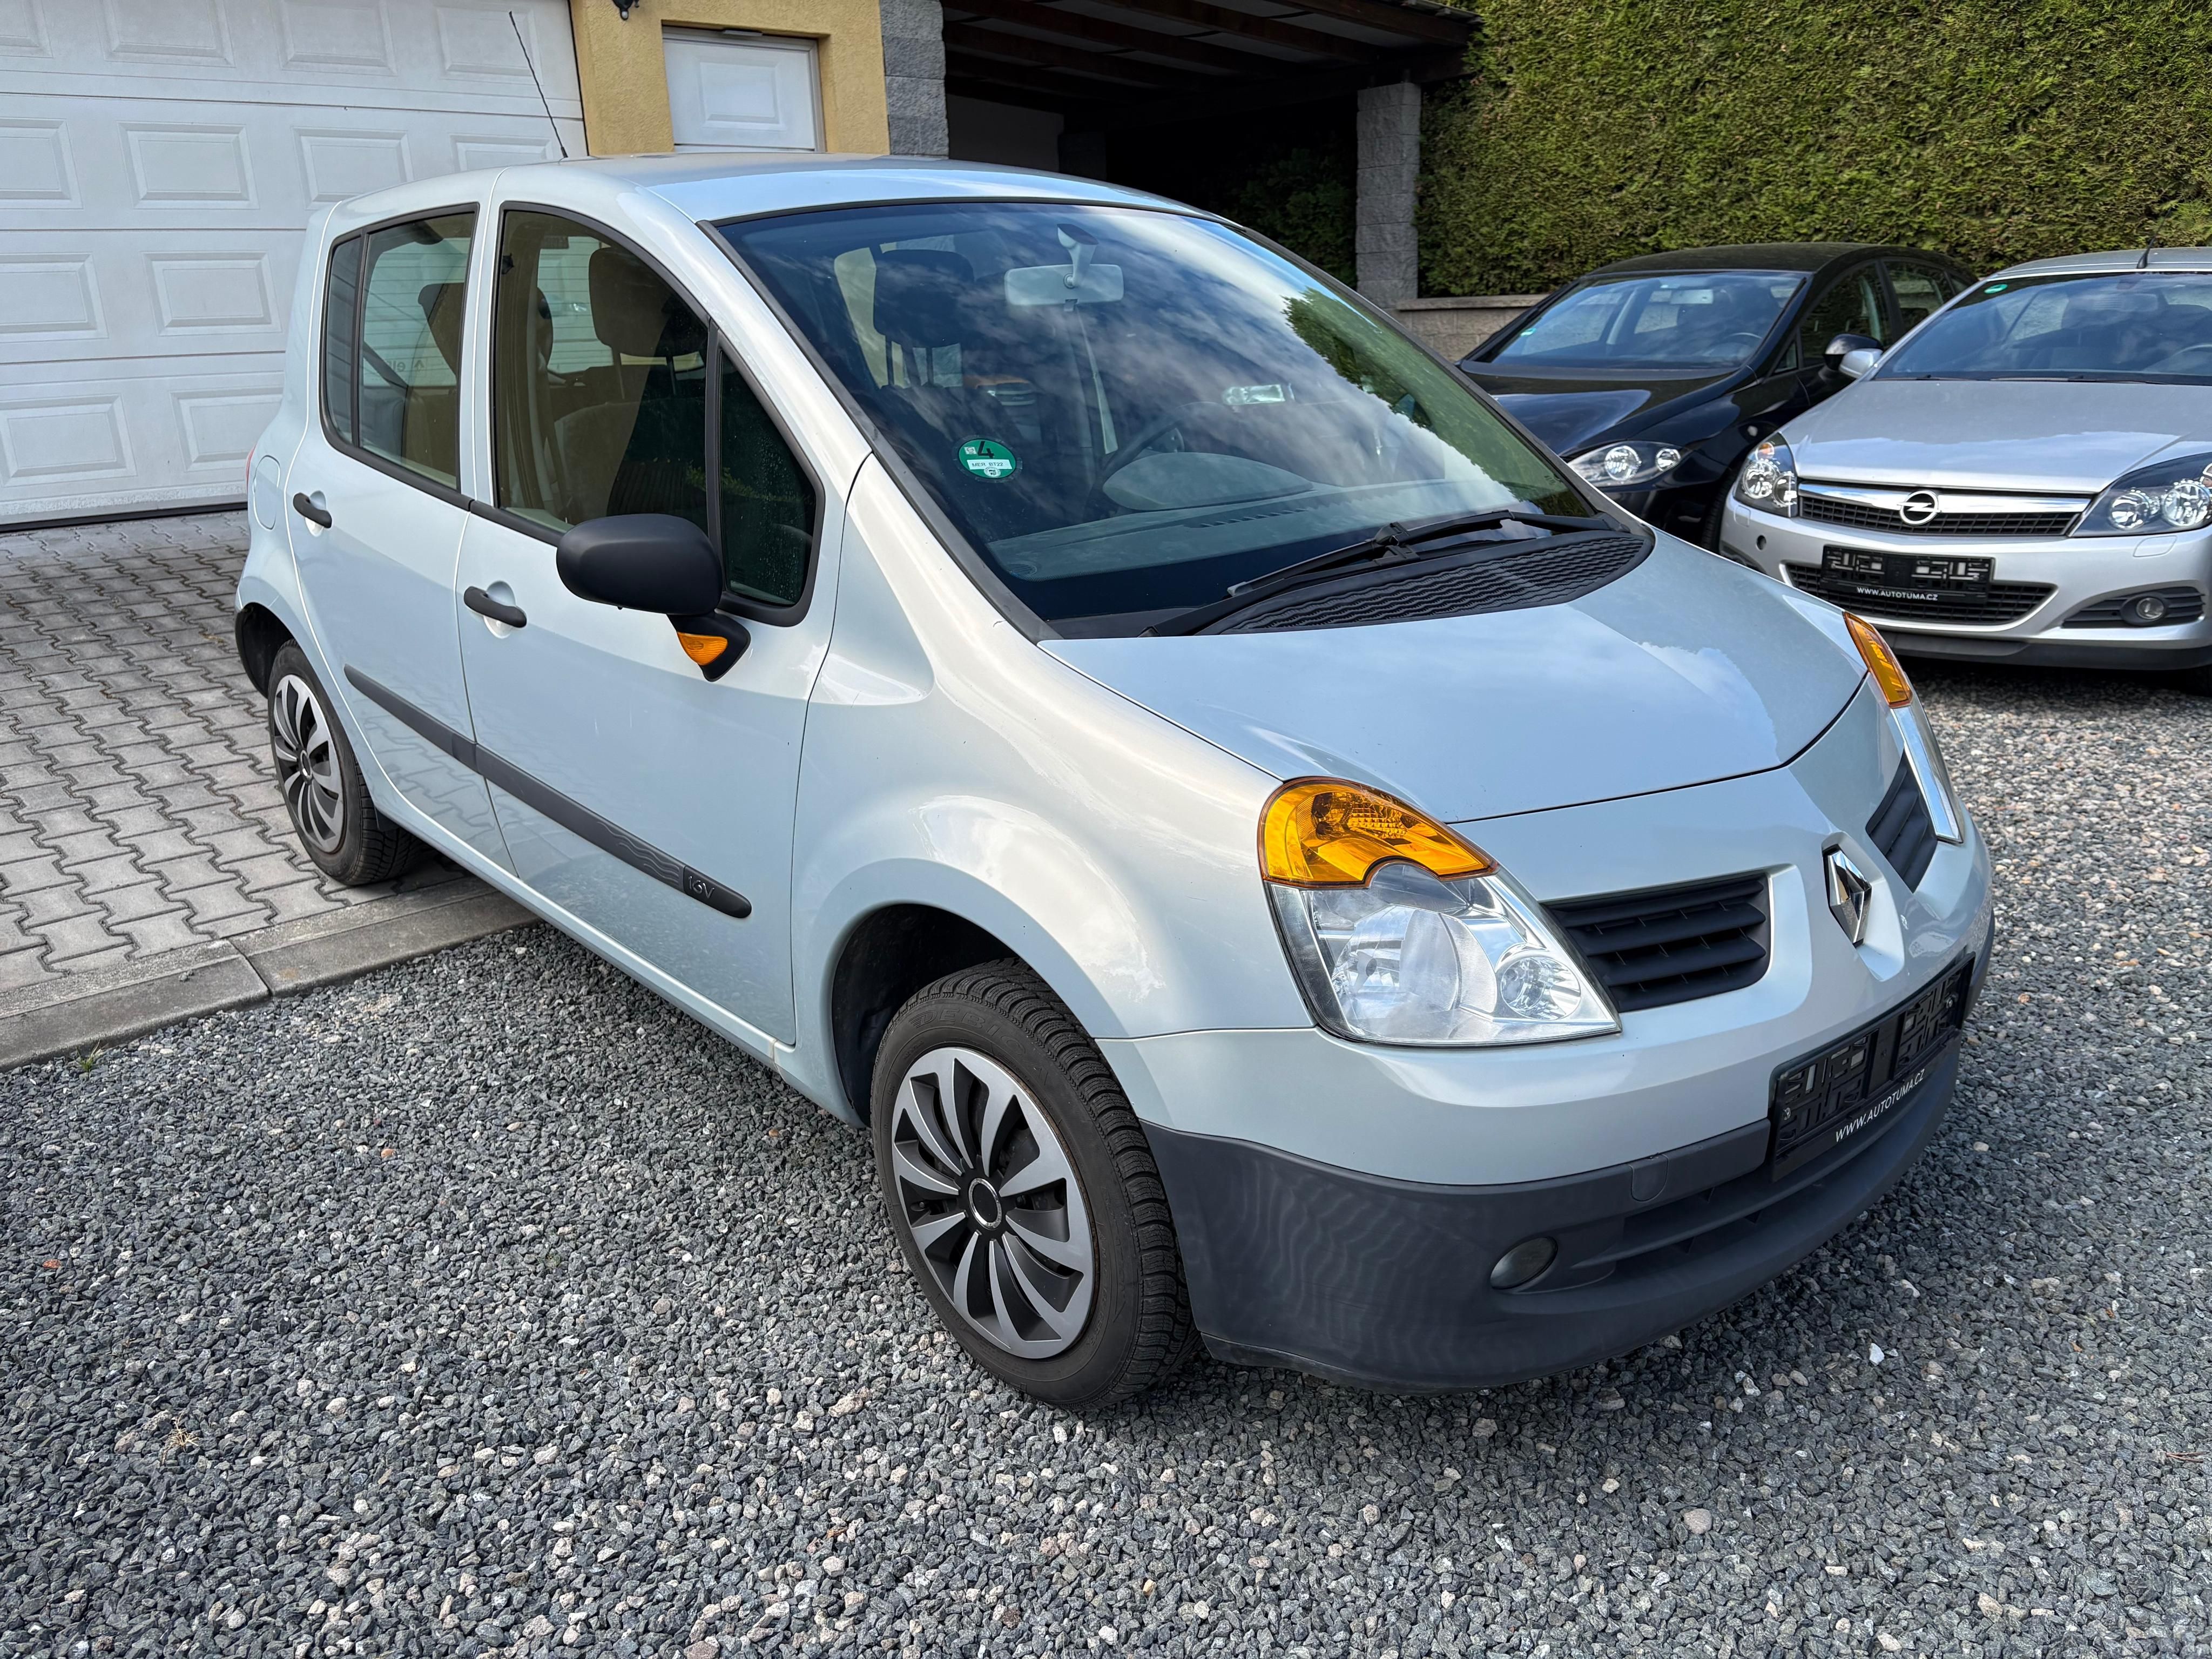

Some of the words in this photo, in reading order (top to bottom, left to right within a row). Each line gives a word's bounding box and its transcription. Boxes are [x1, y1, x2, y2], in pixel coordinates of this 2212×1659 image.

[978, 441, 994, 458] 4
[1857, 586, 1938, 601] WWW.AUTOTUMA.CZ
[688, 875, 715, 899] 16V
[1835, 1069, 1925, 1143] WWW.AUTOTUMA.CZ
